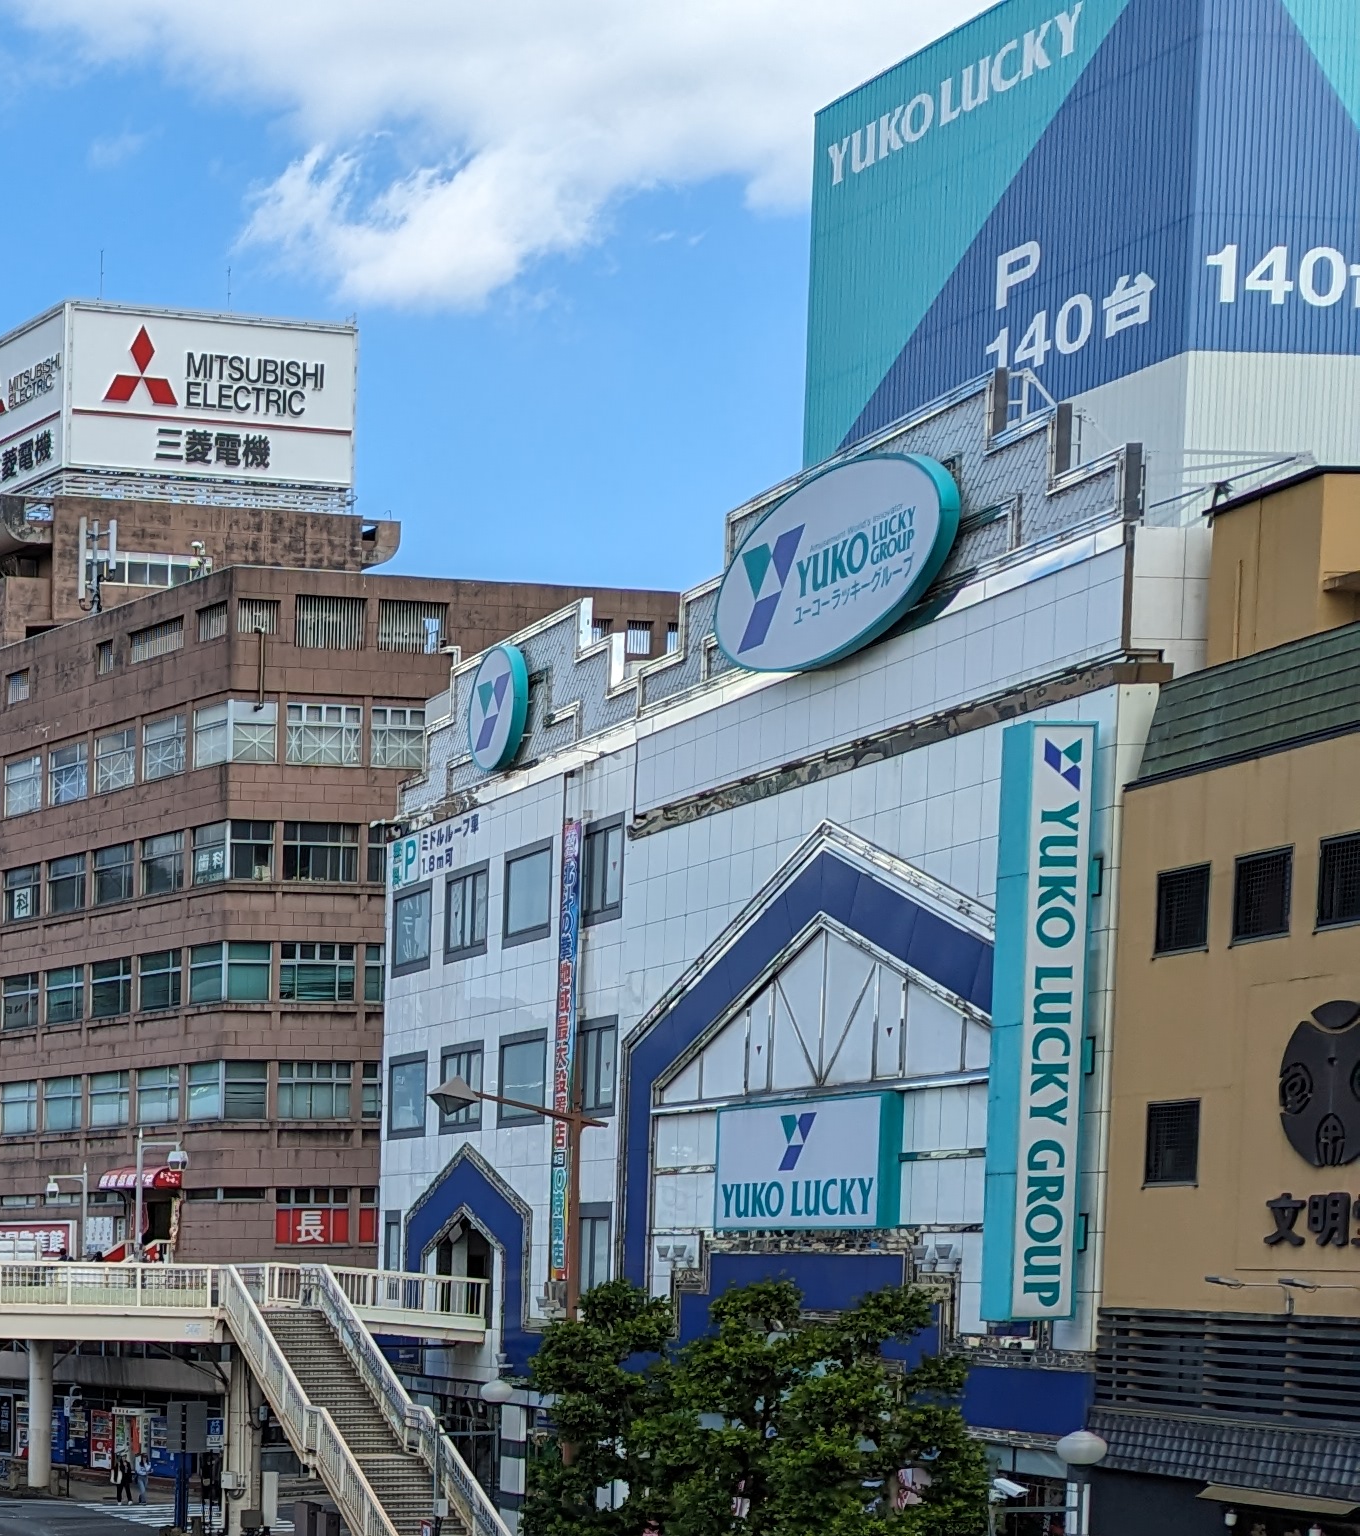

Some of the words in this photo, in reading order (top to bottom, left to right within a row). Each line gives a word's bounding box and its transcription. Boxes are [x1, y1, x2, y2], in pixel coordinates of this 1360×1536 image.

[828, 91, 934, 186] YUKO
[938, 4, 1083, 128] LUCKY
[995, 240, 1041, 311] P
[1206, 244, 1360, 307] 140
[985, 271, 1157, 369] 140台
[8, 352, 61, 393] MITSUBISHI
[8, 373, 56, 410] ELECTRIC
[186, 352, 325, 391] MITSUBISHI
[186, 381, 306, 418] ELECTRIC
[155, 428, 271, 470] 三菱電機
[872, 505, 917, 543] LUCKY
[796, 532, 869, 599] YUKO
[870, 529, 915, 566] GROUP
[793, 552, 914, 625] ユーコーラッキーグループ
[422, 813, 480, 851] ミドルルーフ車
[405, 839, 417, 880] P
[1035, 800, 1081, 950] YUKO
[1028, 964, 1074, 1127] LUCKY
[721, 1181, 784, 1218] YUKO
[790, 1177, 874, 1217] LUCKY
[295, 1210, 325, 1244] 長
[1022, 1139, 1066, 1308] GROUP
[1263, 1192, 1360, 1248] 文明
